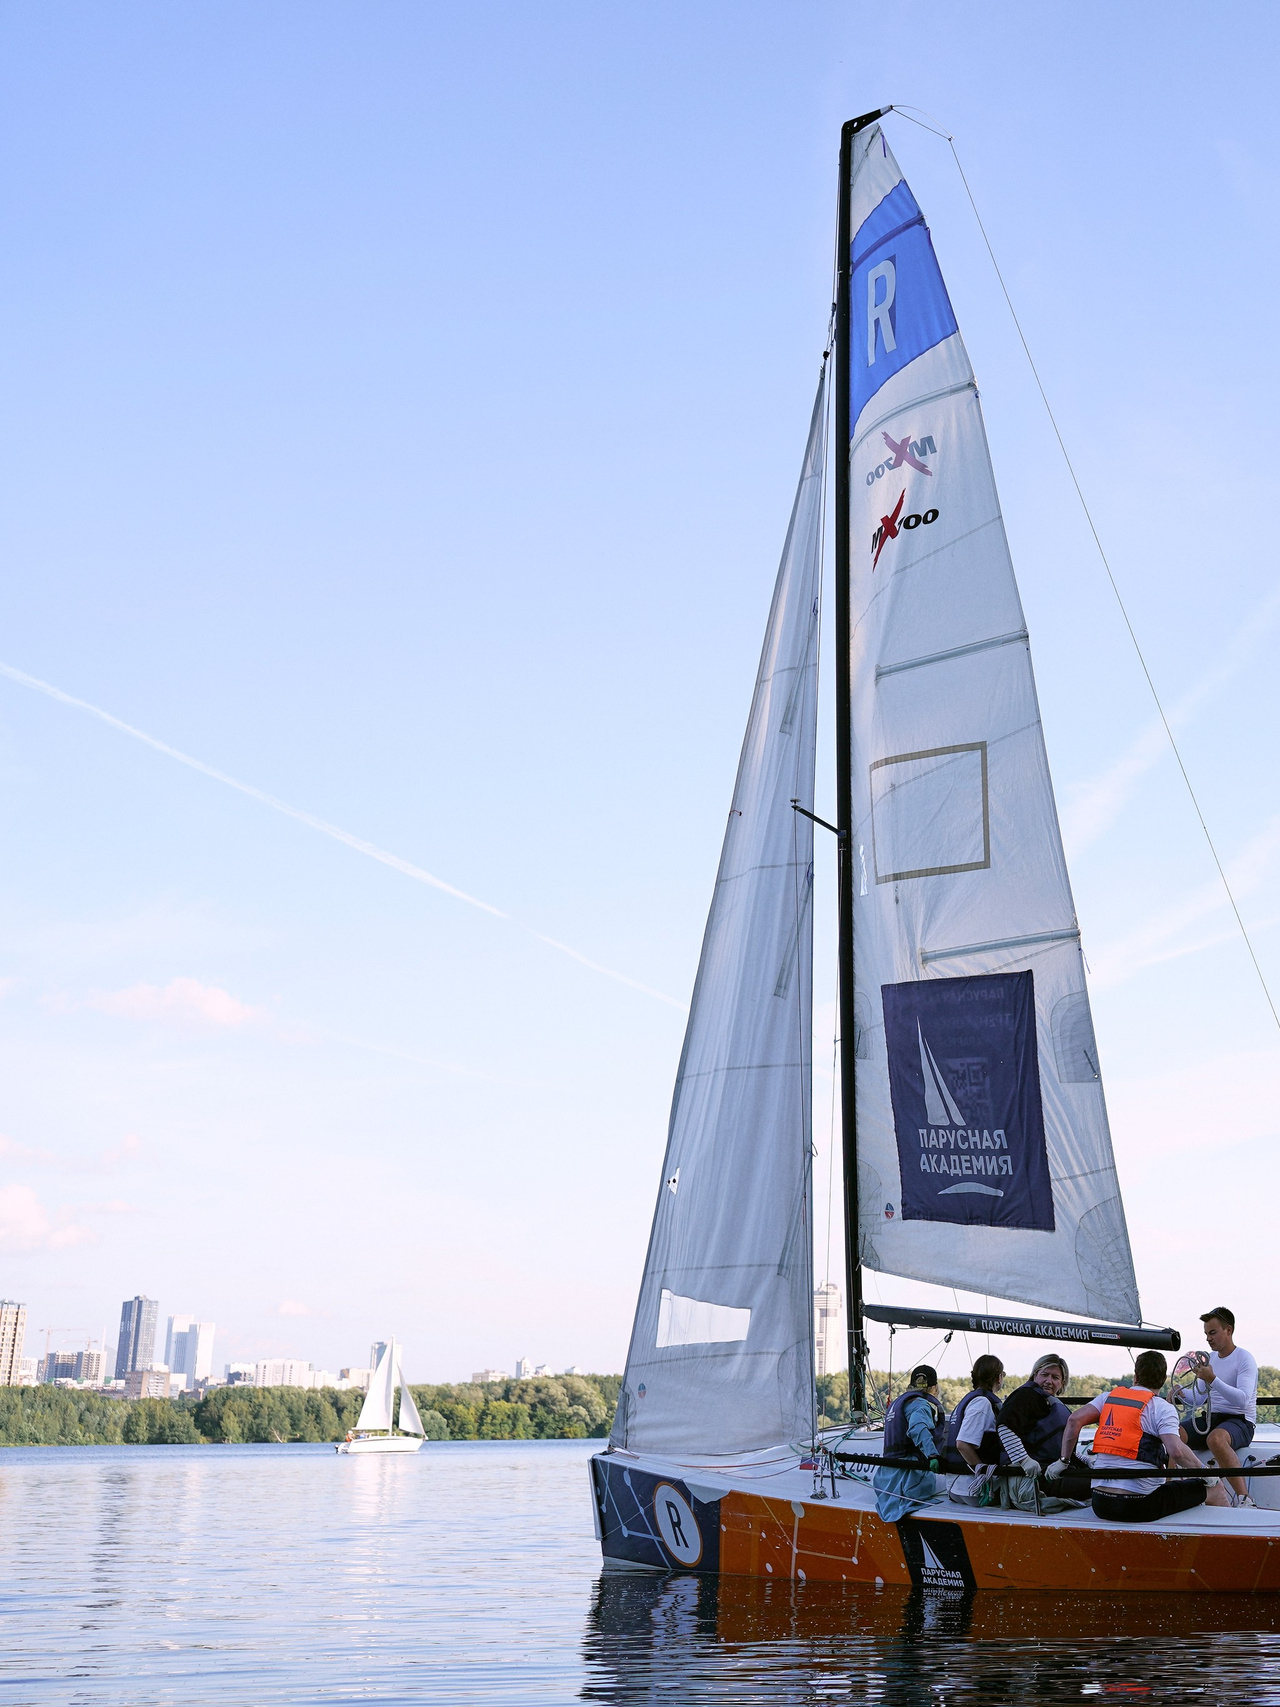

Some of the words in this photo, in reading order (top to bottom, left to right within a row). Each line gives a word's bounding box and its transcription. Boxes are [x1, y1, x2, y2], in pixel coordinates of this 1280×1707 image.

[867, 259, 898, 368] R
[918, 1128, 1009, 1150] ПАРУСНАЯ
[920, 1153, 1013, 1177] АКАДЕМИЯ
[981, 1319, 1032, 1335] ПАРУСНАЯ
[1034, 1324, 1090, 1341] АКАДЕМИЯ
[664, 1500, 690, 1549] R
[920, 1567, 962, 1579] ПАРУСНАЯ
[922, 1576, 965, 1588] АКАДЕМИЯ
